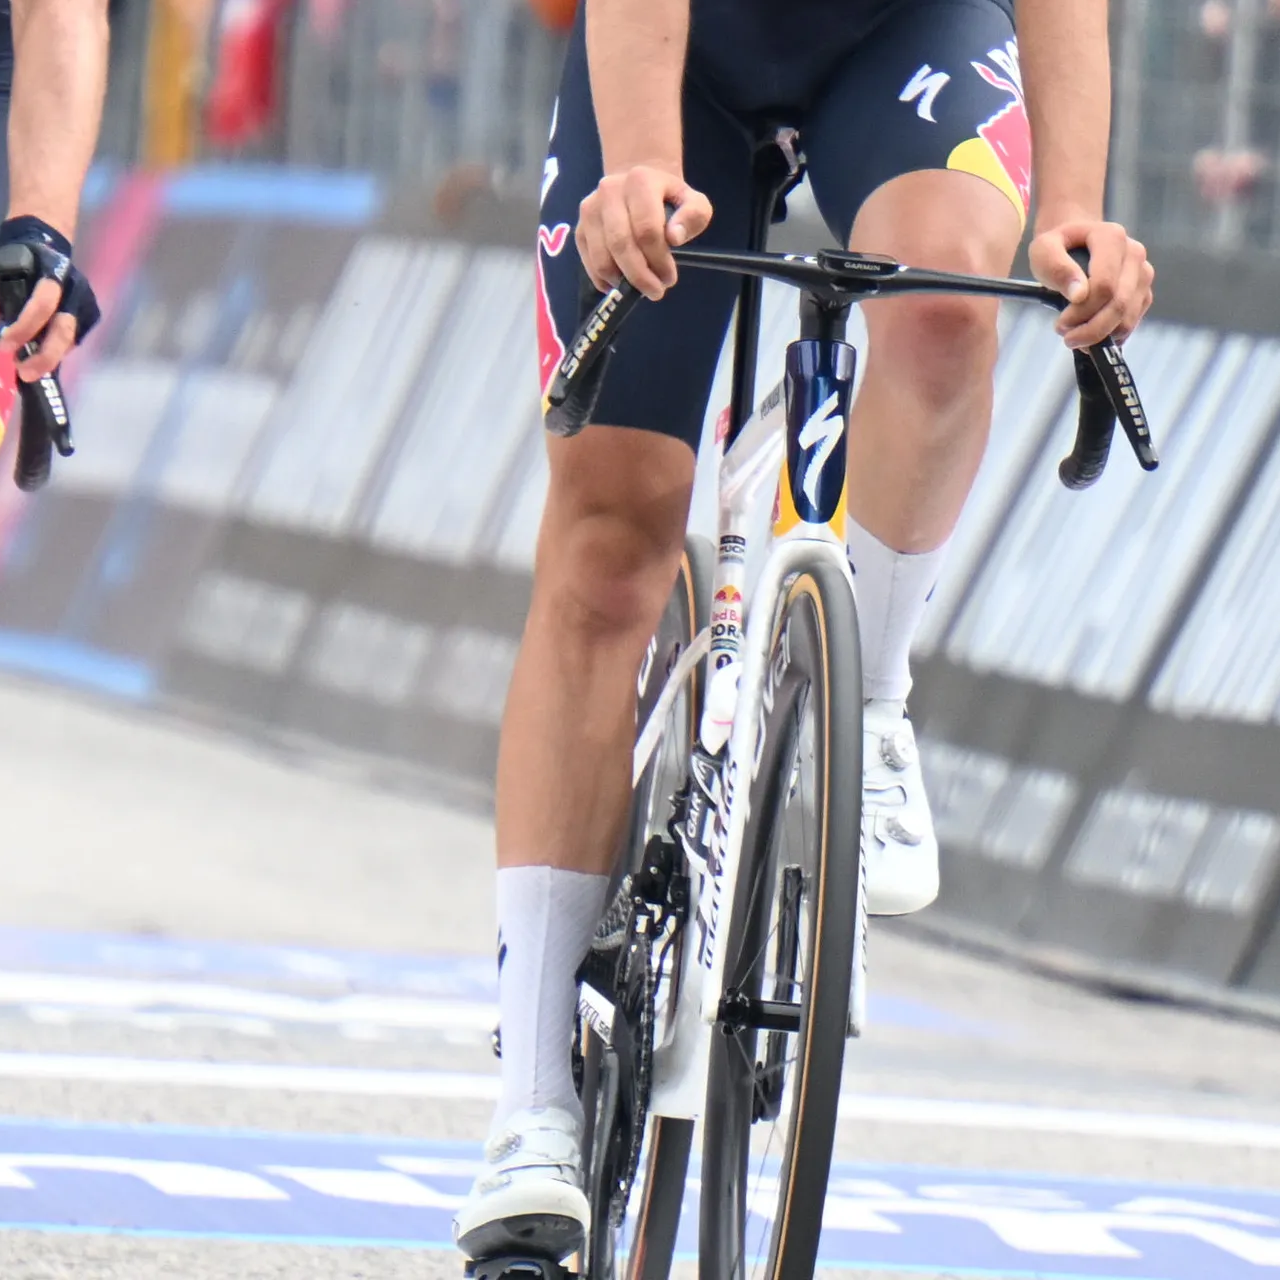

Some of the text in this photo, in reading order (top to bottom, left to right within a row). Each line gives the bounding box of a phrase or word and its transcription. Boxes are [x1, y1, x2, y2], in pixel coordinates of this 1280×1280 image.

[844, 261, 881, 272] GARMIN
[559, 287, 624, 378] SRAM
[1102, 343, 1151, 438] SRAM
